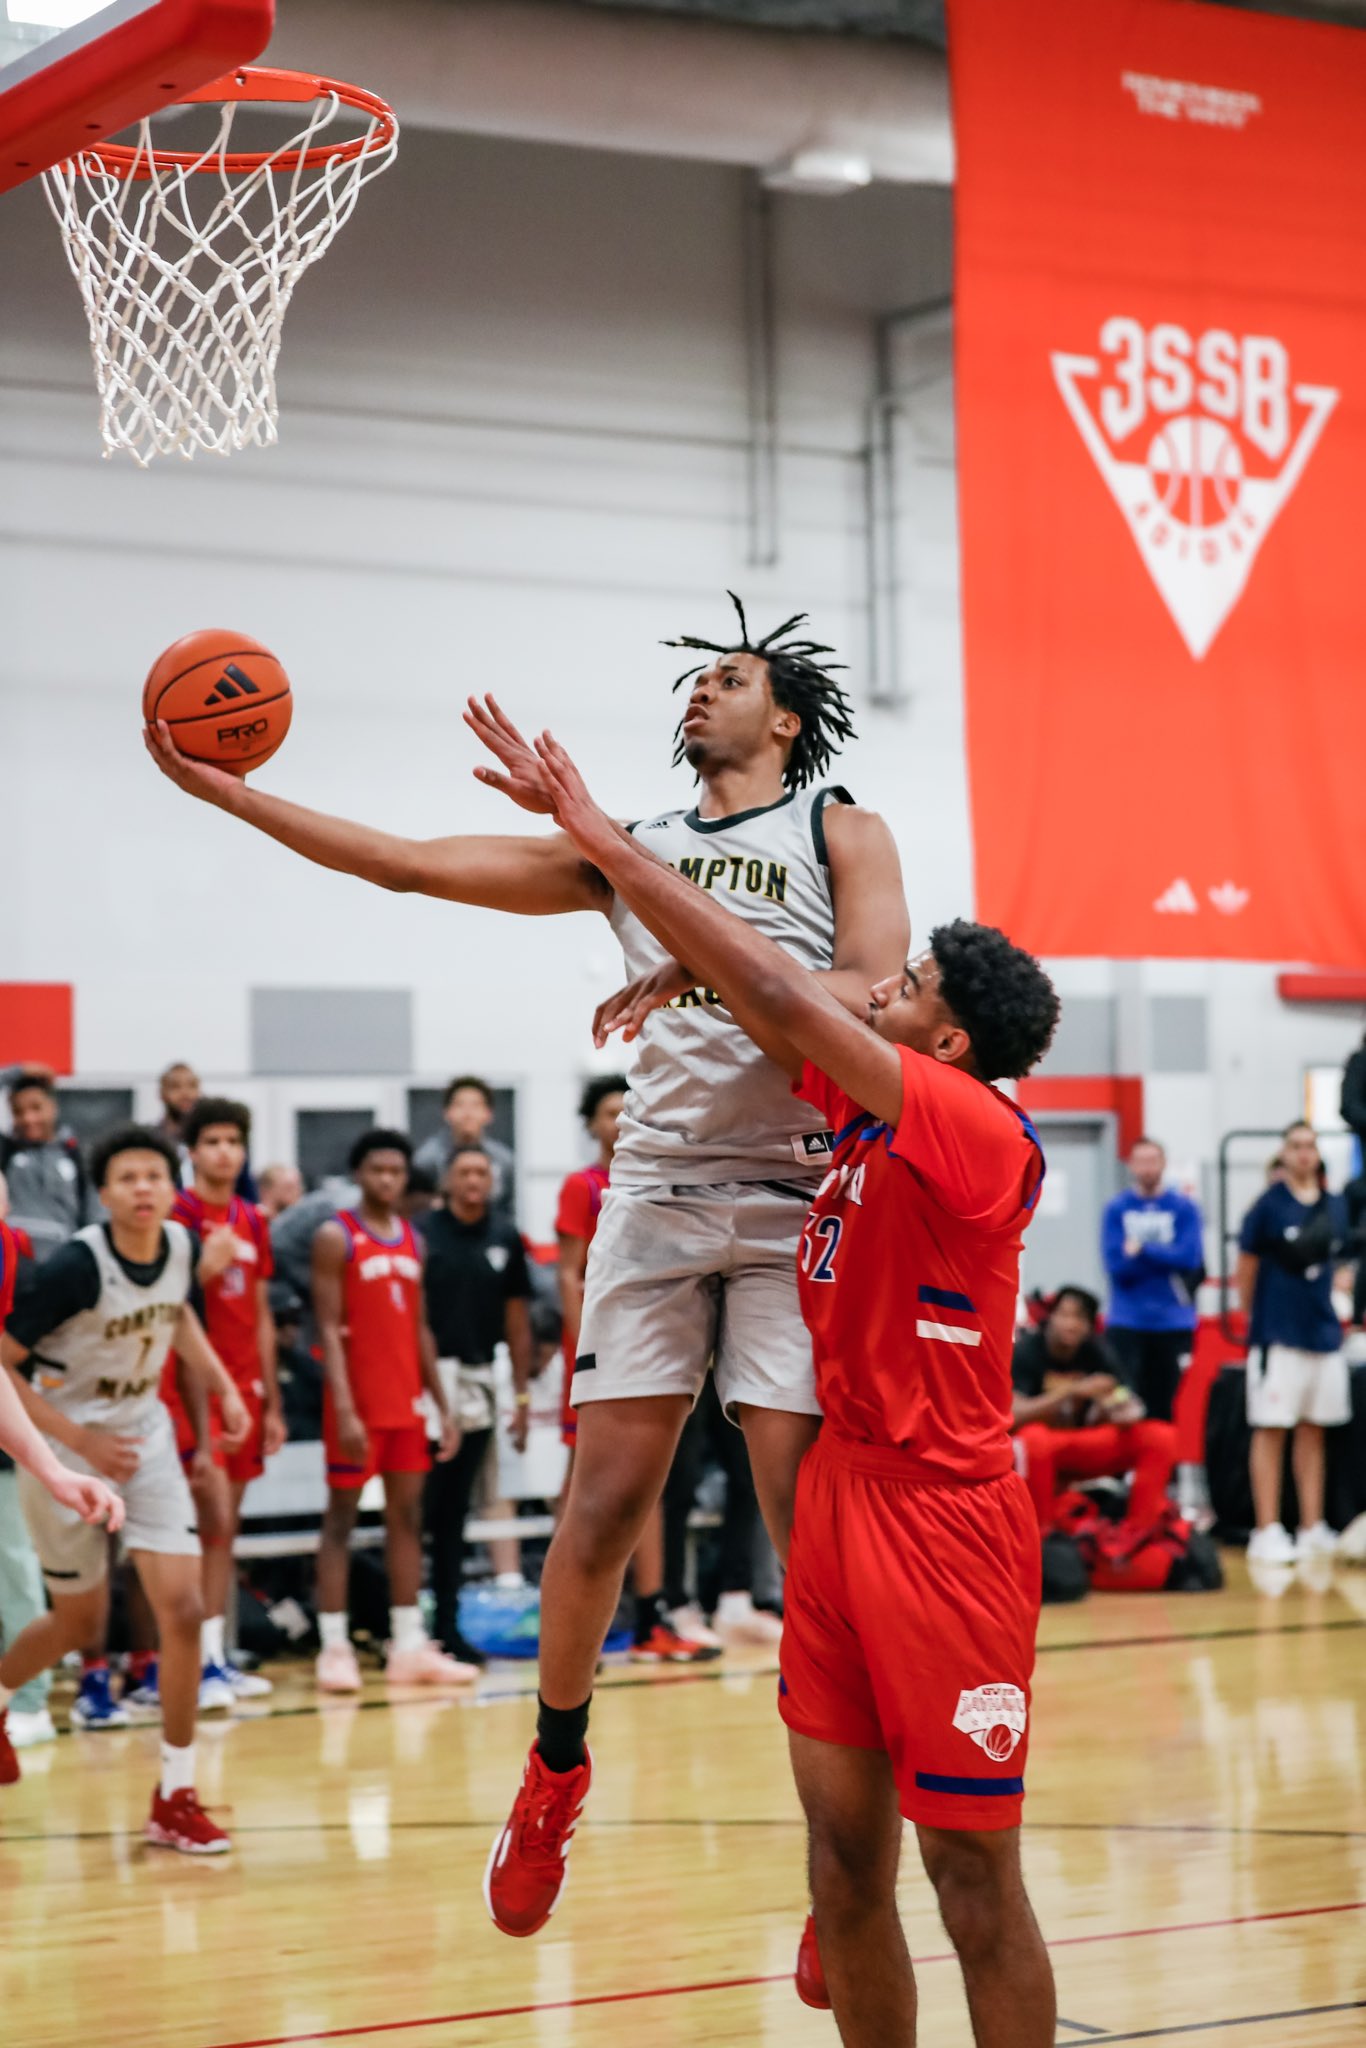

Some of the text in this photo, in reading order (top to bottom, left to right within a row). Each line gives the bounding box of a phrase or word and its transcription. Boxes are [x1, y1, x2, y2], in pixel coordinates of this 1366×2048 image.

[1099, 316, 1289, 461] 3SSB
[216, 718, 268, 742] PRO
[667, 856, 788, 903] MPTON
